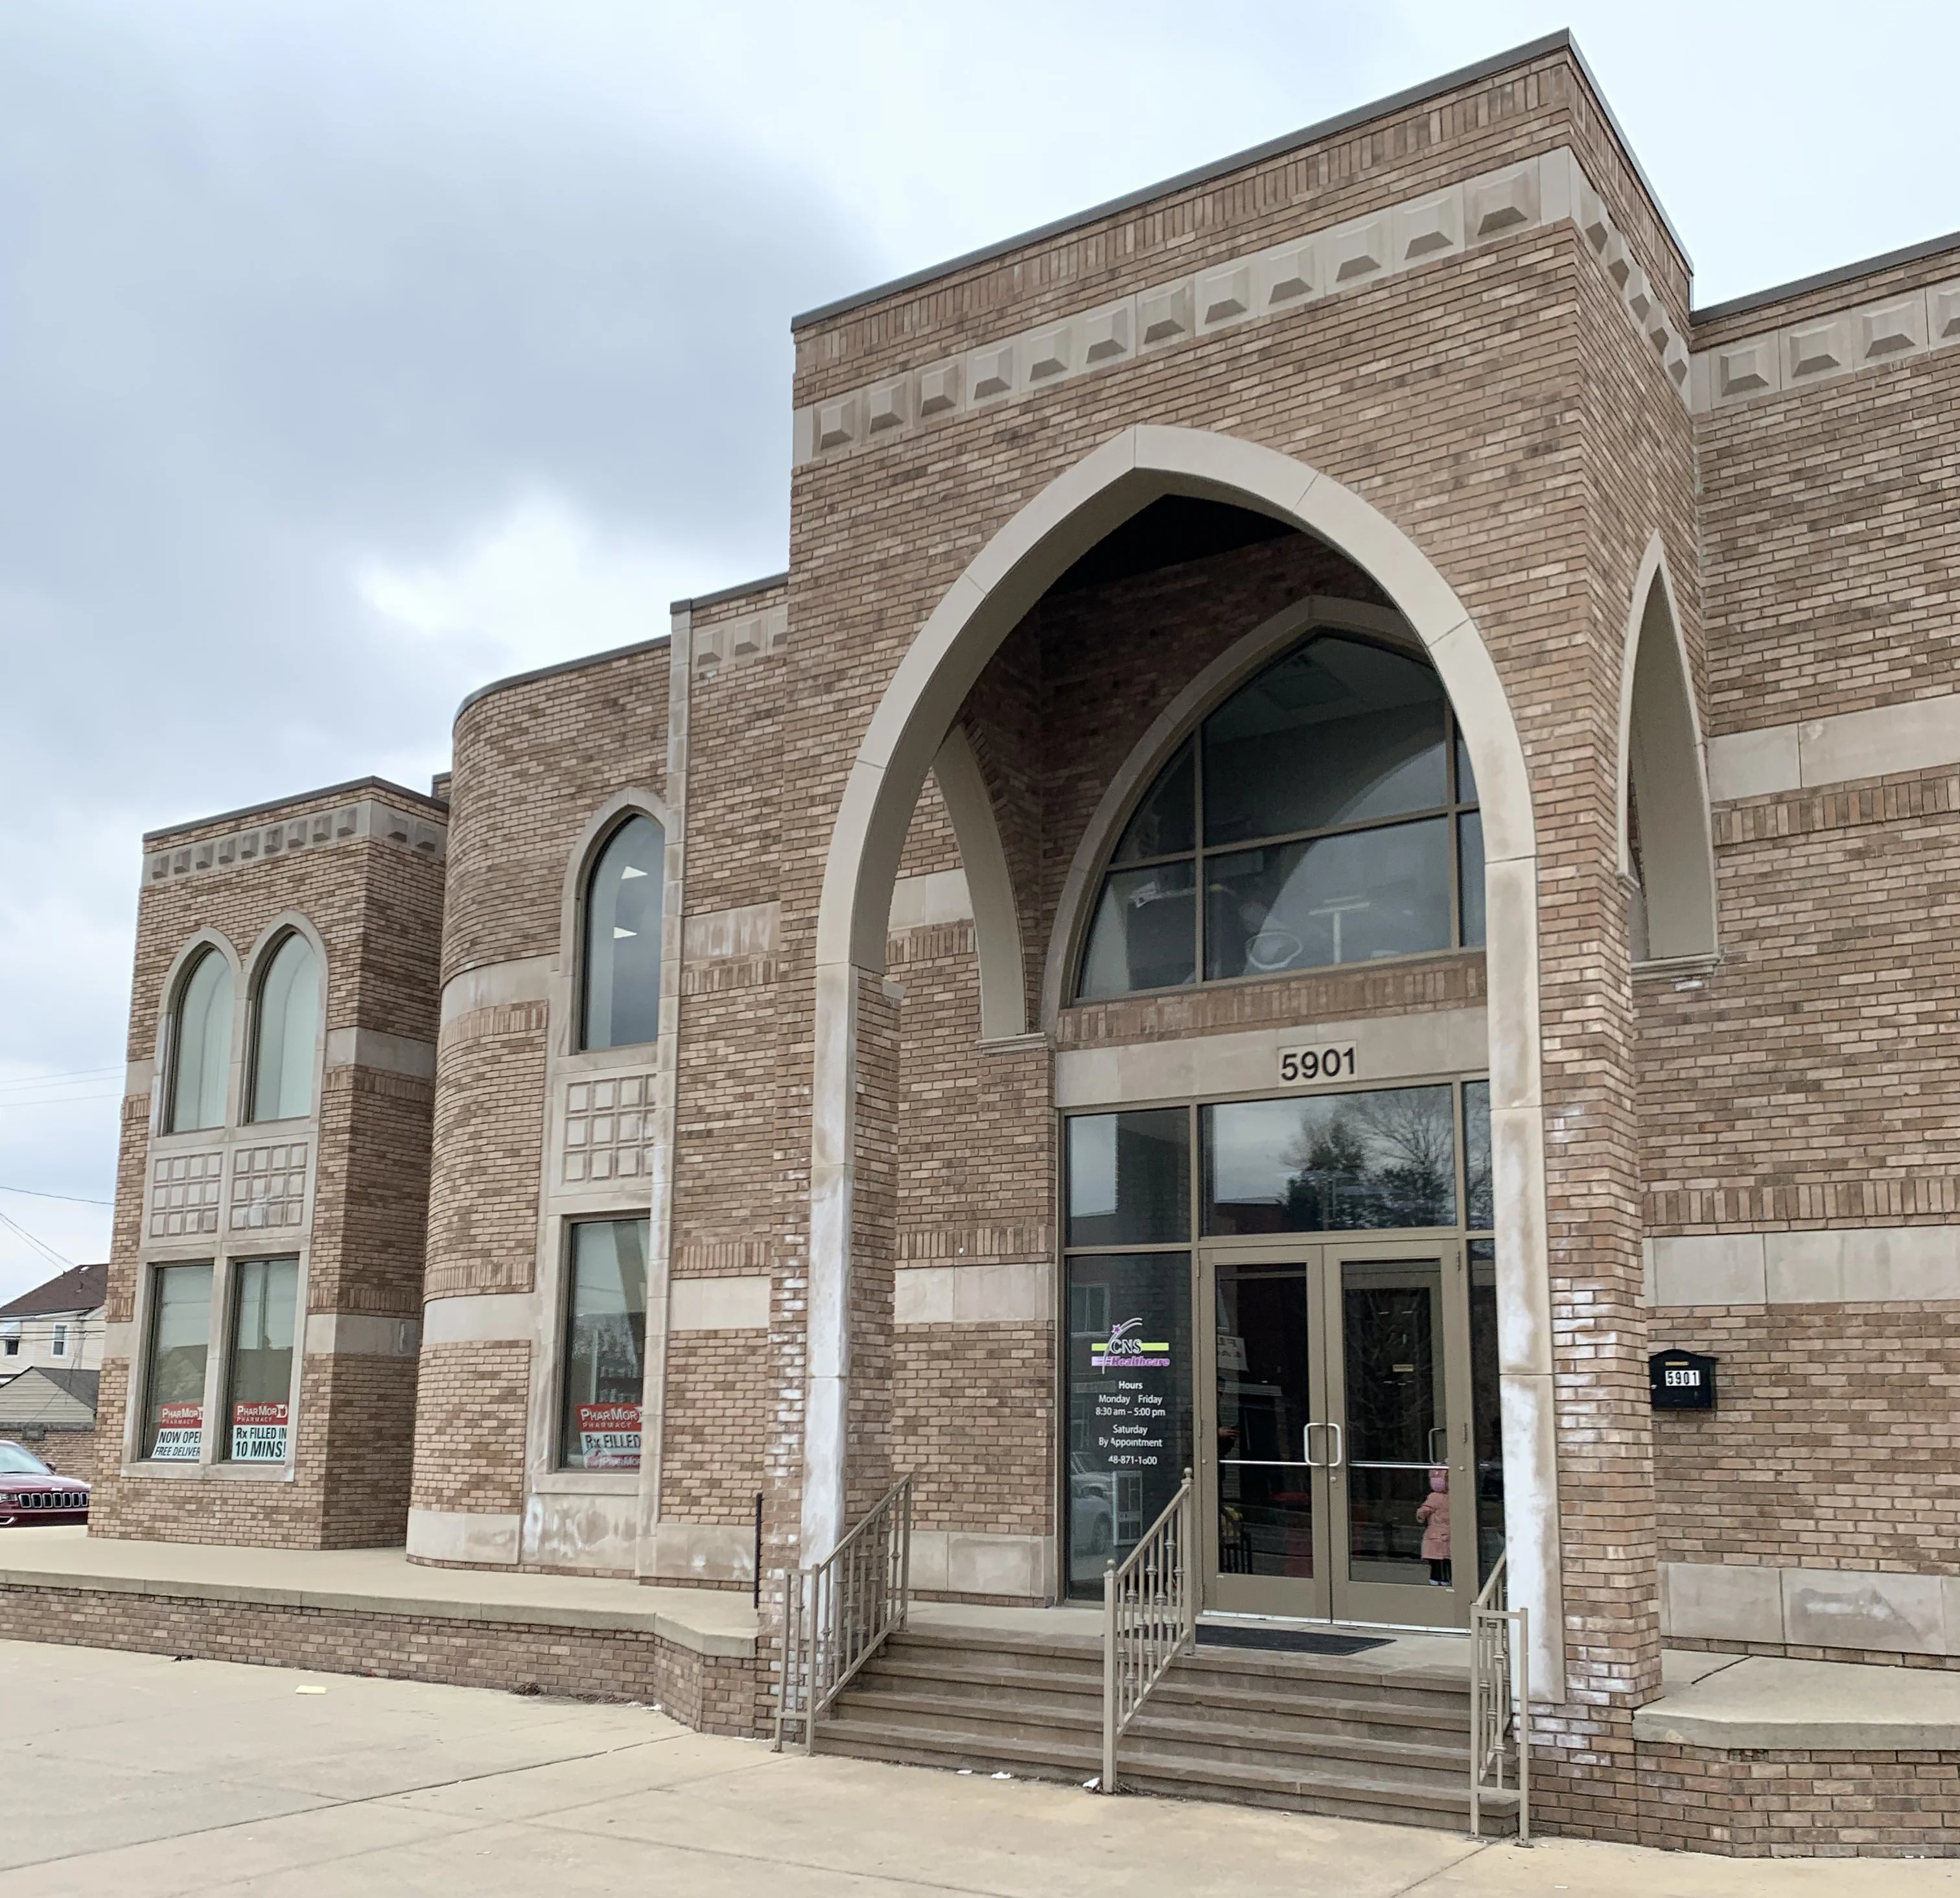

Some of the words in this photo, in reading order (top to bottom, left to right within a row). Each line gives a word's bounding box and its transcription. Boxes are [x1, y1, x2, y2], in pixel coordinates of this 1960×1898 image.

[1281, 1047, 1355, 1081] 5901
[1110, 1339, 1142, 1353] CNS
[1111, 1355, 1170, 1366] Healthcare
[1667, 1372, 1697, 1385] 5901
[1118, 1381, 1143, 1389] Hours
[1099, 1394, 1130, 1405] Monday
[1138, 1394, 1163, 1405] Friday
[1095, 1407, 1112, 1416] 8:30
[1134, 1407, 1150, 1416] 5:00
[1152, 1409, 1165, 1418] pm
[236, 1427, 248, 1439] Rx
[250, 1427, 277, 1439] FILLED
[279, 1427, 287, 1439] IN
[1113, 1424, 1148, 1436] Saturday
[159, 1431, 181, 1443] NOW
[585, 1435, 601, 1449] Rx
[603, 1435, 640, 1448] FILLED
[1099, 1437, 1109, 1447] By
[1110, 1437, 1163, 1447] Appointment
[154, 1447, 172, 1456] FREE
[235, 1441, 248, 1457] 10
[250, 1441, 286, 1457] MINS!
